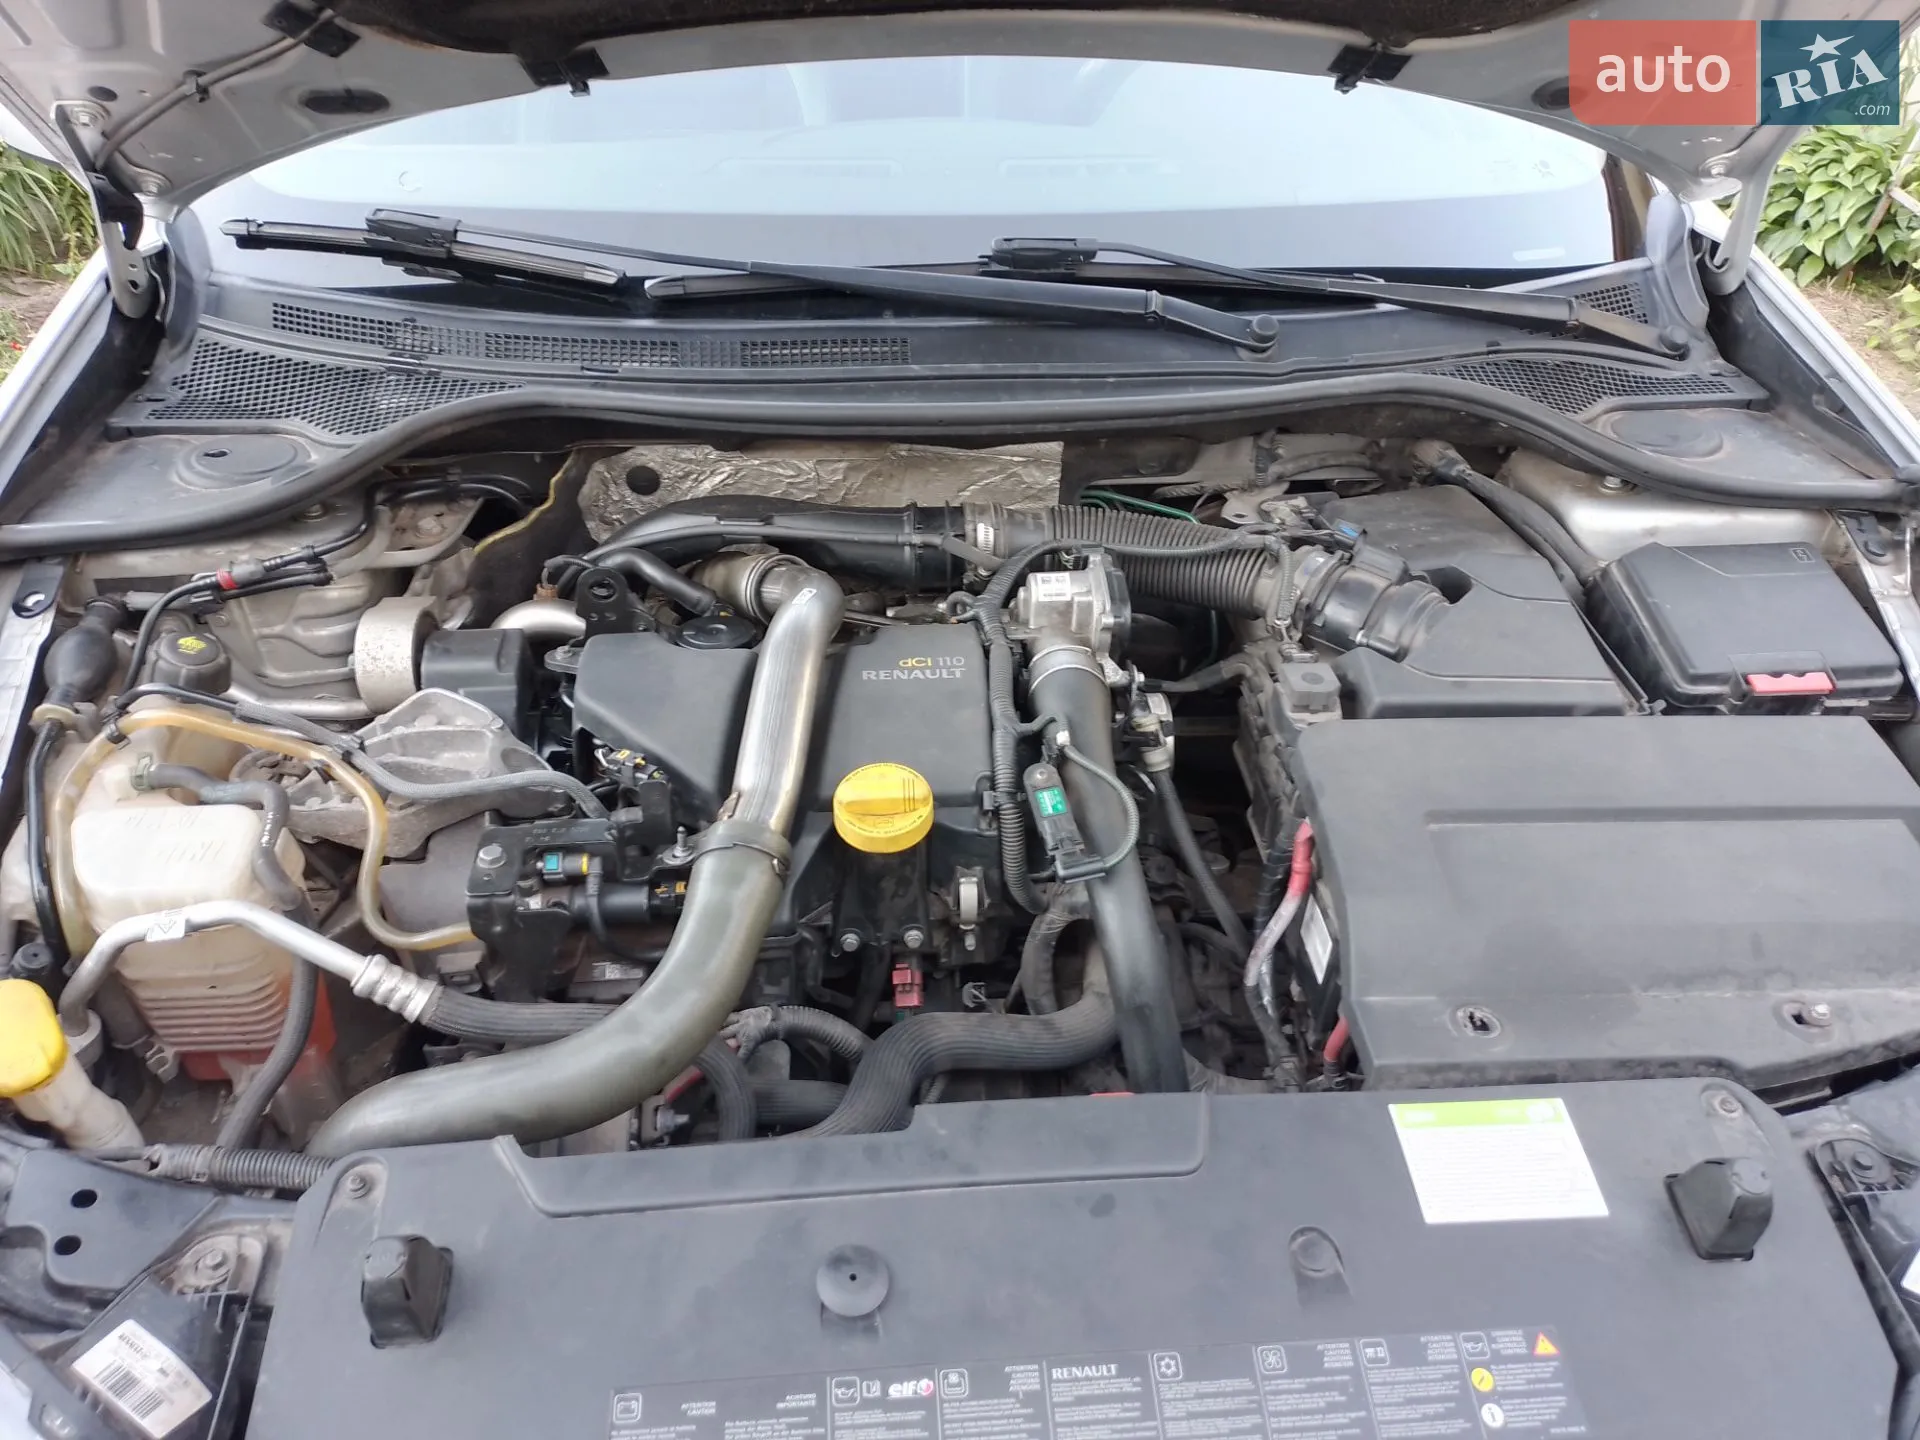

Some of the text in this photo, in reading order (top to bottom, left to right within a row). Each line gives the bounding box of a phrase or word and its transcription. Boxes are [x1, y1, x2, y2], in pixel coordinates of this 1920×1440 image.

[936, 656, 965, 667] 110
[862, 668, 966, 681] RENAULT
[1051, 1364, 1119, 1380] RENAULT
[887, 1379, 917, 1397] elf
